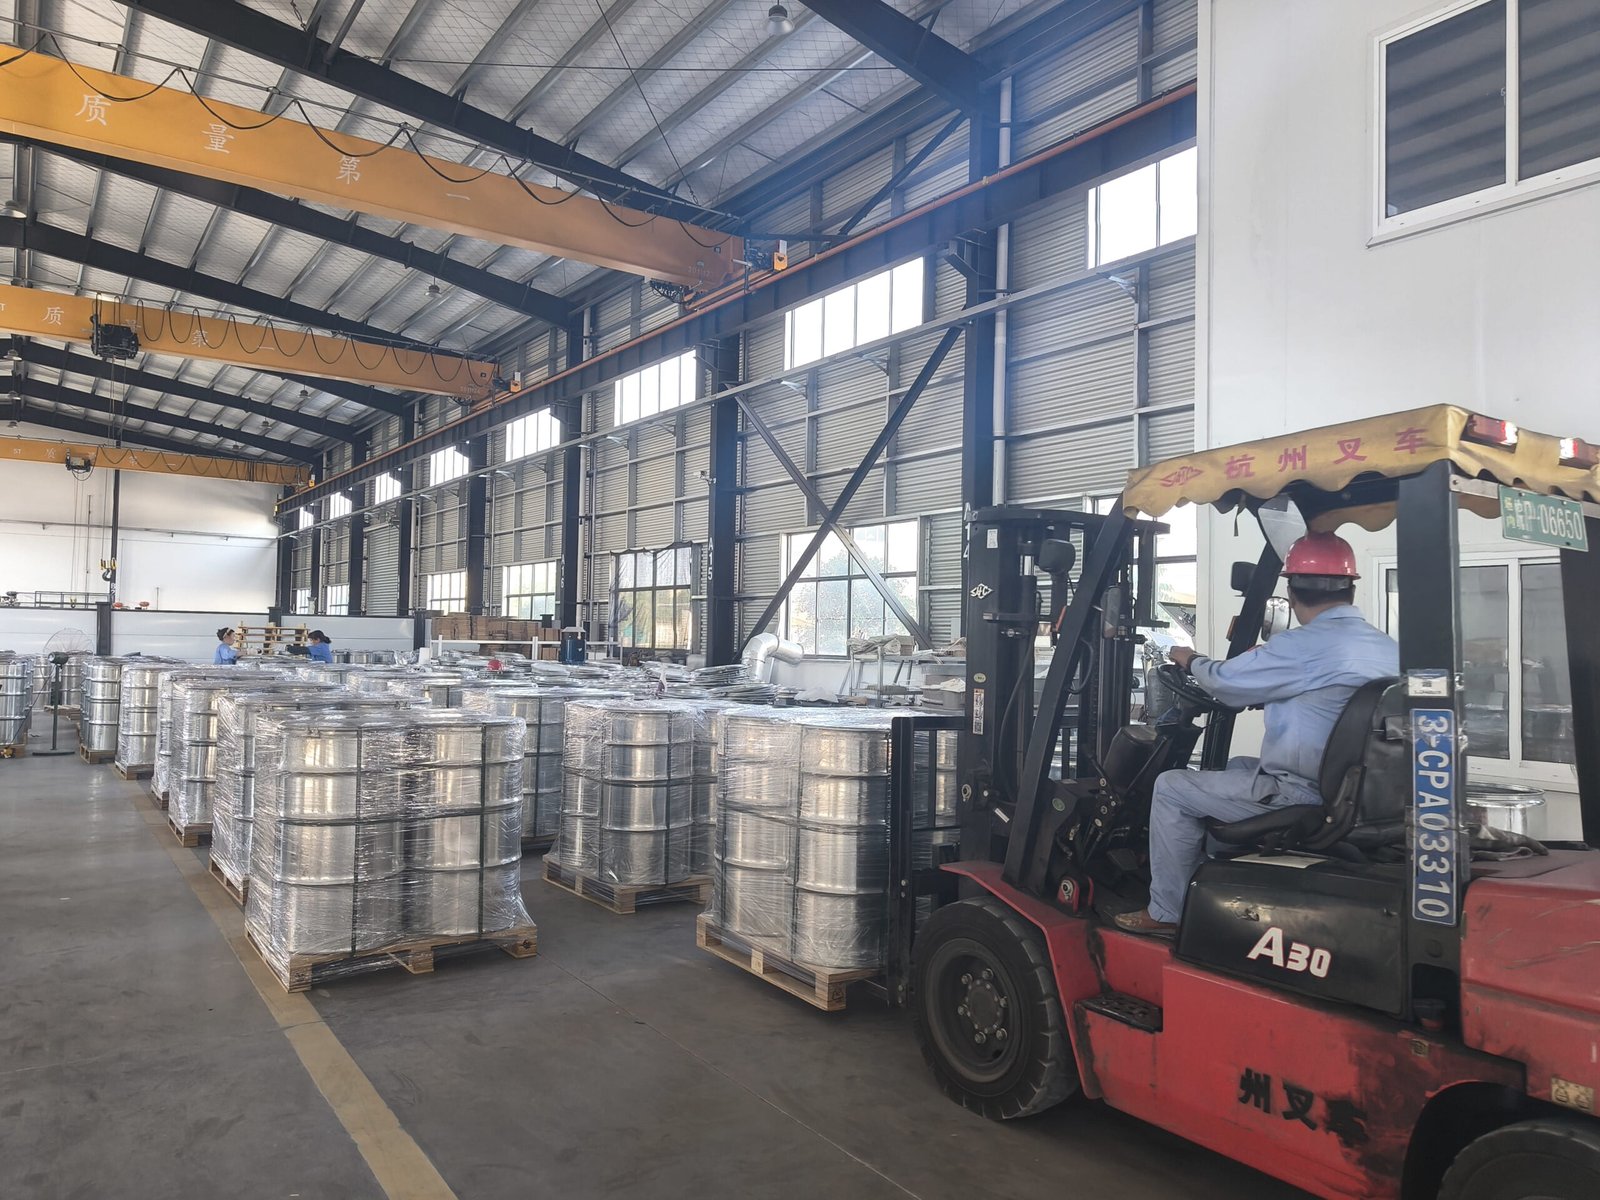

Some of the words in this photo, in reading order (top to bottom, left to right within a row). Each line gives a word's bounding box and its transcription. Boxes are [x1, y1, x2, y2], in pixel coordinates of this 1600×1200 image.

[75, 93, 471, 202] 质量第一
[1225, 427, 1427, 479] 杭州叉车
[1417, 715, 1451, 919] 3-CPA03310
[1247, 927, 1331, 978] A30
